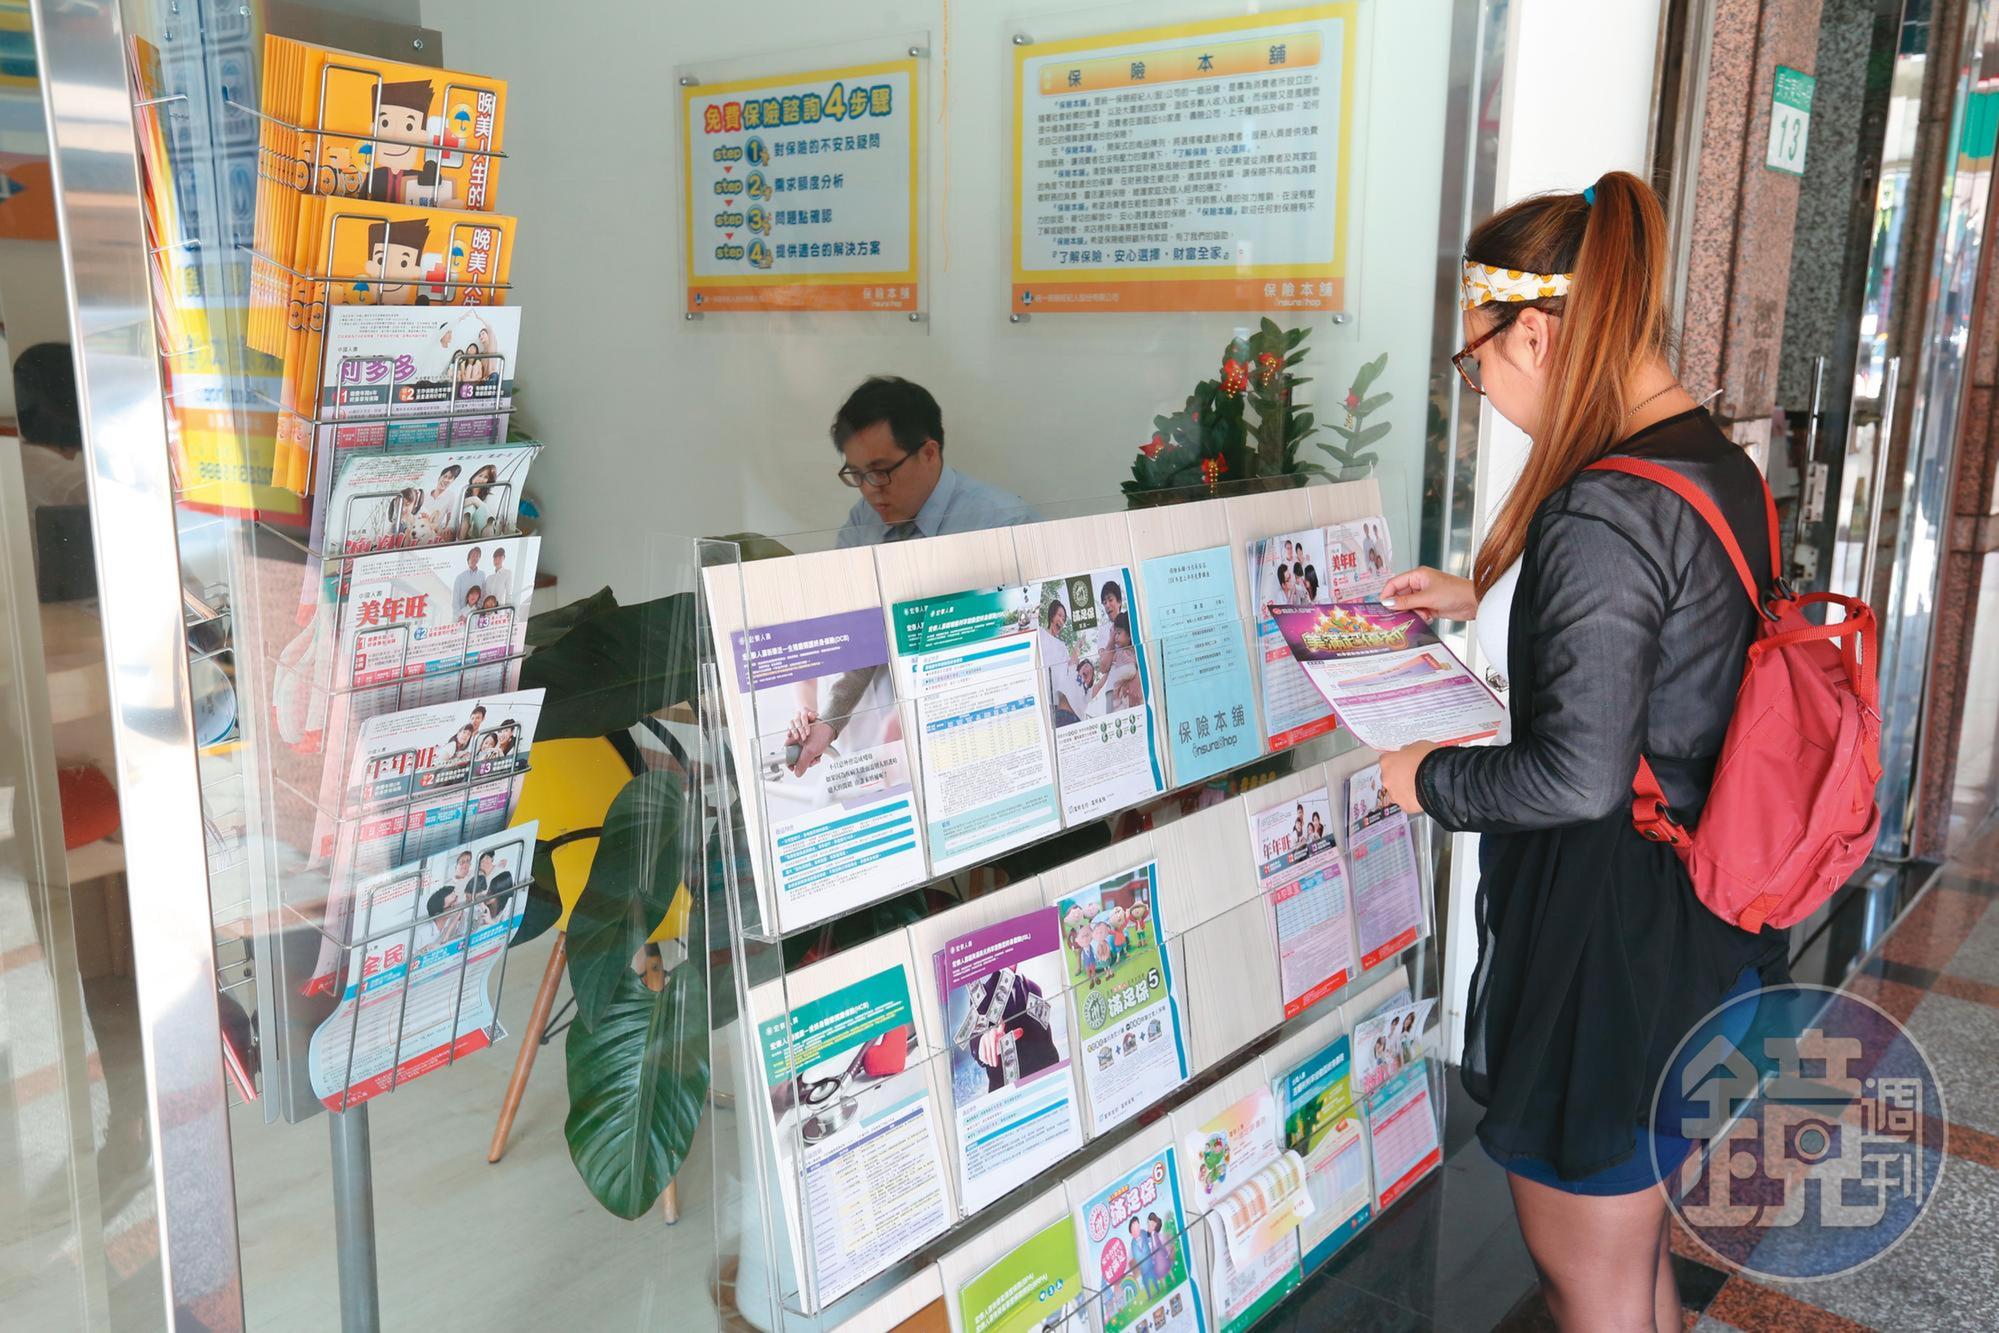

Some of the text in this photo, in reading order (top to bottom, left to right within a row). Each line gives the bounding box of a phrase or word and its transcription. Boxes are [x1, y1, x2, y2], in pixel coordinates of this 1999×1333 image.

[704, 82, 892, 134] 免費保險諮詢4步驟
[466, 91, 495, 210] 晚美人生的
[713, 145, 743, 163] step
[774, 133, 881, 157] 對保險的不安及疑問
[1778, 114, 1801, 161] 13
[714, 178, 743, 195] step
[775, 174, 844, 193] 需求額度分析
[715, 211, 744, 228] step
[775, 209, 832, 226] 問題點確認
[715, 244, 744, 261] step
[776, 240, 881, 258] 提供適合的解決方案
[356, 592, 429, 627] 美年旺
[1179, 704, 1245, 745] 保險本舖
